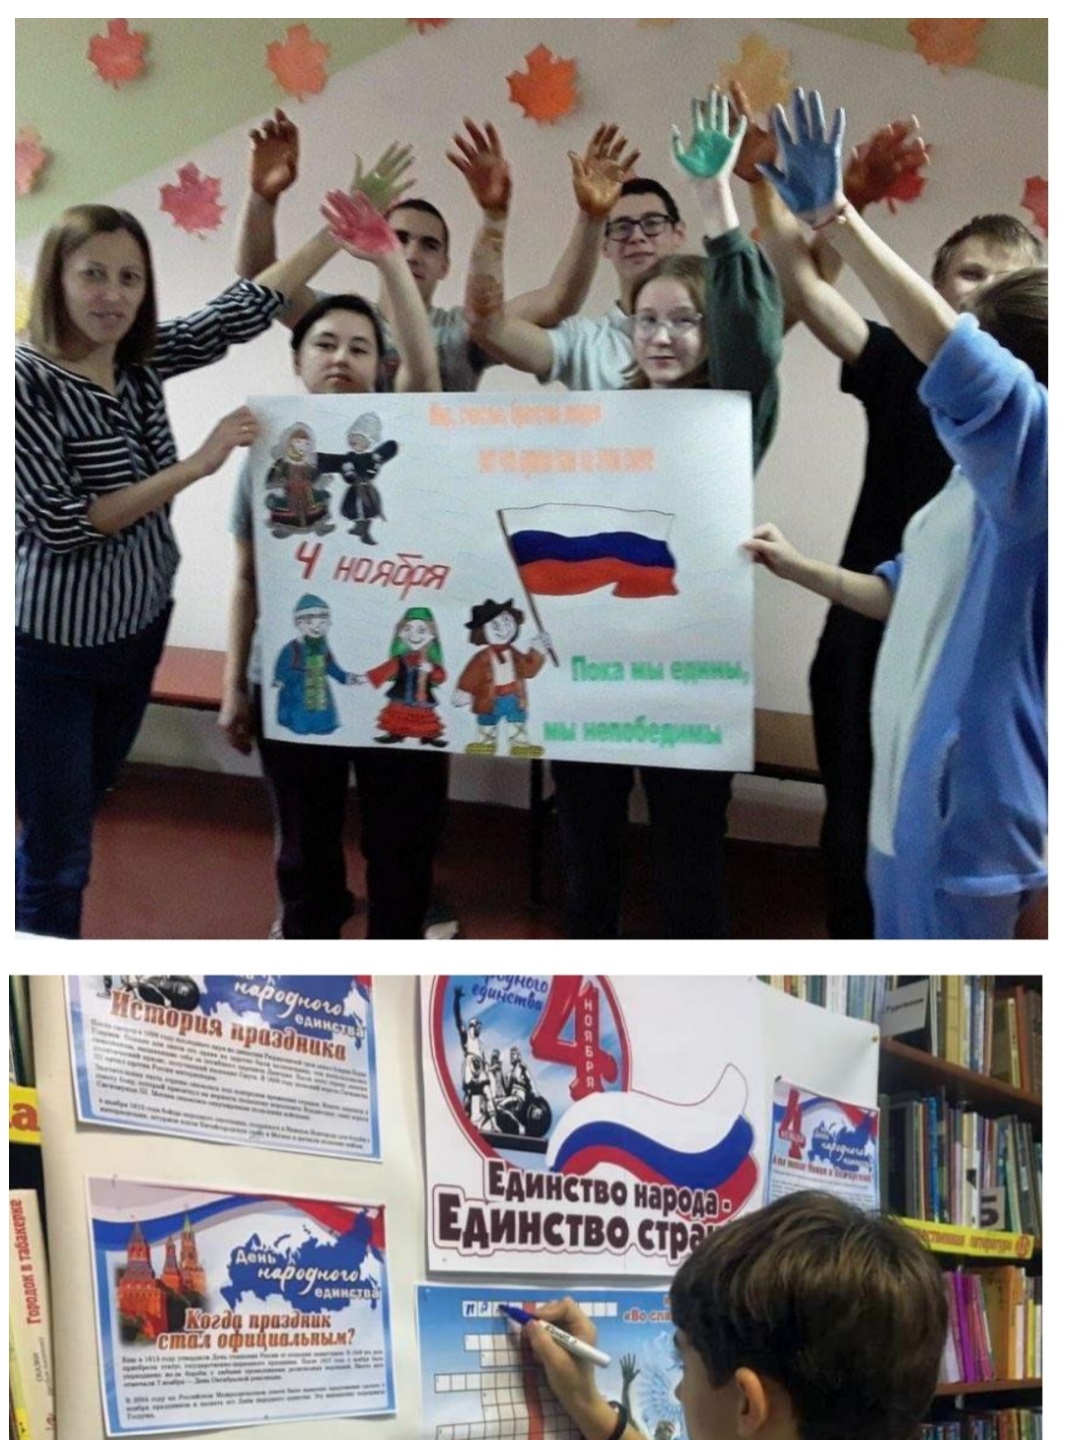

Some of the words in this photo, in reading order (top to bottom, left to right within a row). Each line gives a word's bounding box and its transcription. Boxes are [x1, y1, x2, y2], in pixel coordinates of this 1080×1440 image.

[295, 541, 323, 581] 4
[333, 550, 452, 600] ноября
[472, 984, 543, 1012] единства
[109, 990, 224, 1038] История
[230, 1022, 348, 1062] праздника
[294, 1013, 366, 1040] единства
[529, 975, 619, 1101] 4
[583, 999, 596, 1089] НОЯБРЯ
[634, 1184, 718, 1218] народа
[9, 1199, 32, 1261] табакерке
[235, 1249, 277, 1265] День
[258, 1259, 360, 1295] народного
[314, 1286, 381, 1301] единства
[20, 1275, 42, 1325] Городок
[185, 1310, 243, 1333] Когда
[249, 1311, 332, 1333] праздник
[157, 1331, 212, 1351] стал
[217, 1327, 356, 1353] официальным?
